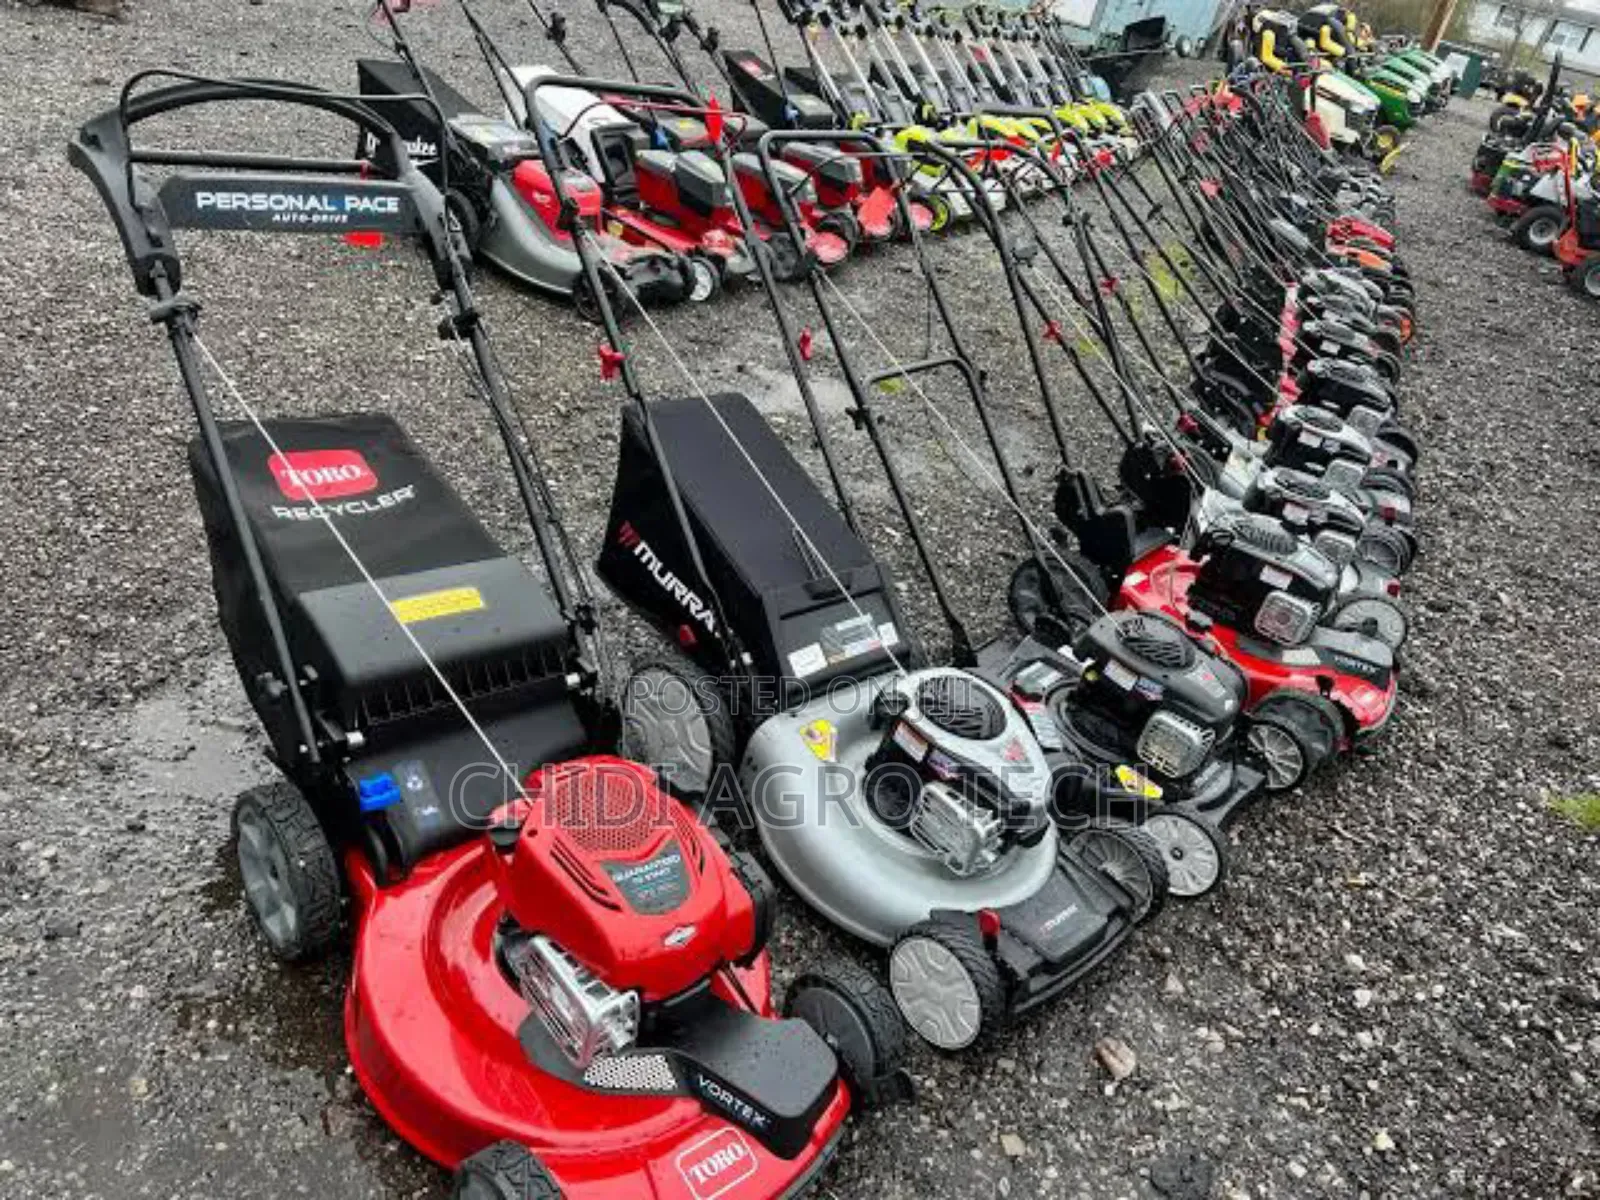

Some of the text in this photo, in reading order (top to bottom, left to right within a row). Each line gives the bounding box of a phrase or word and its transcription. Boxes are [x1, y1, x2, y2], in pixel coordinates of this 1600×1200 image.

[195, 192, 399, 213] PERSONAL PACE
[272, 212, 348, 224] AUTO-DRIVE
[280, 464, 361, 486] TORO
[271, 485, 415, 520] RECYCLER
[633, 540, 716, 634] MURRA
[698, 1074, 767, 1127] VORTEX
[690, 1141, 745, 1185] TORO
